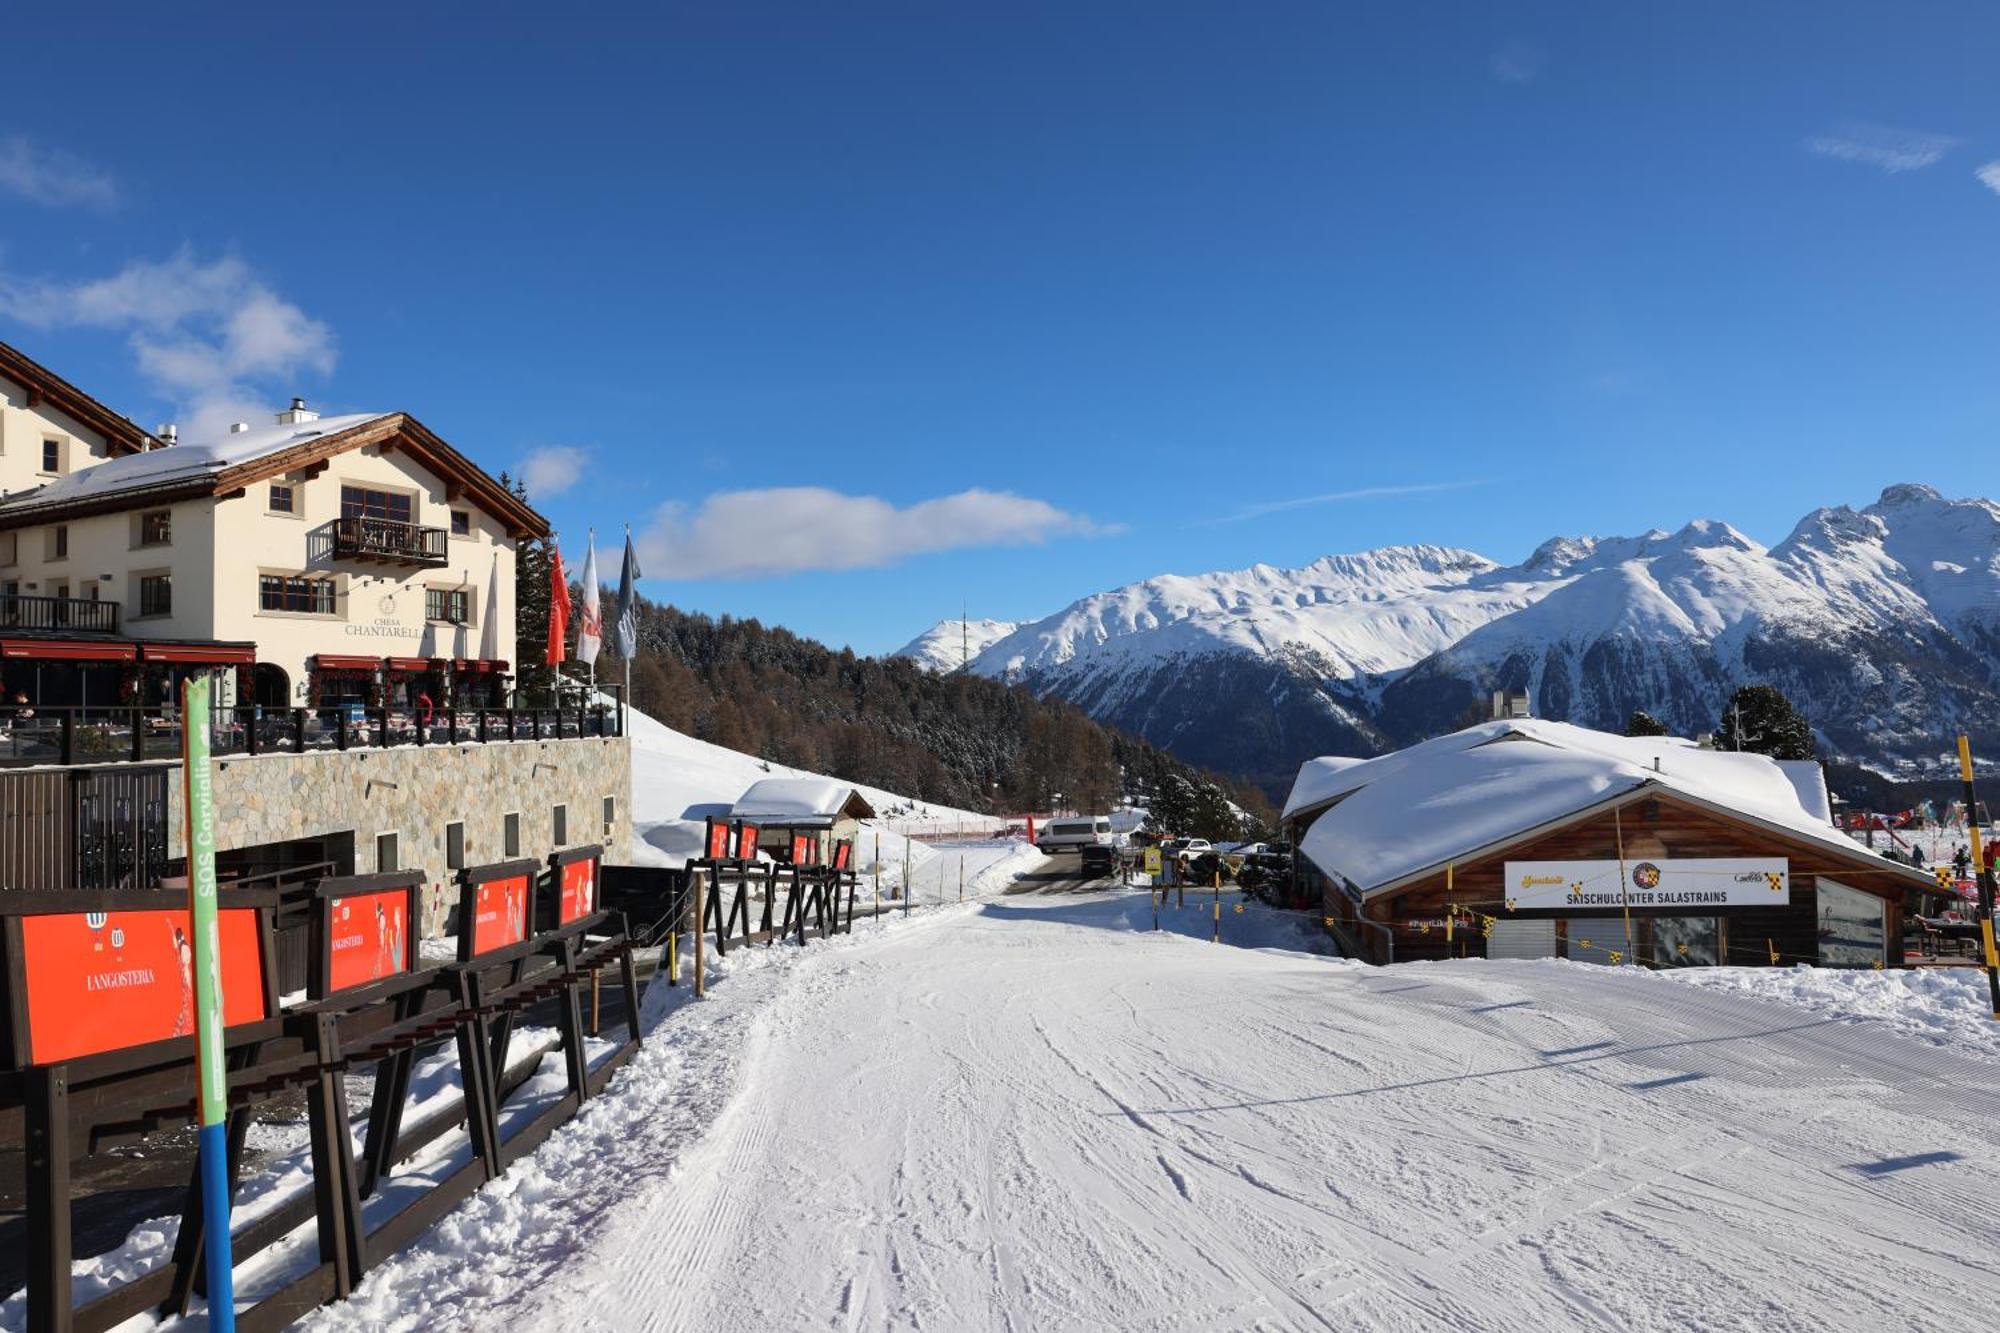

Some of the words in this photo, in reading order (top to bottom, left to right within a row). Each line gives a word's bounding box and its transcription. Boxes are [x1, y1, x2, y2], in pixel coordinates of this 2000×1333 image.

[345, 624, 428, 639] CHANTARELLA
[374, 618, 400, 626] CHESA
[195, 755, 213, 846] Corviglia
[198, 851, 214, 898] SOS
[1658, 891, 1728, 904] SALASTRAINS
[86, 968, 155, 992] LANGOSTERIA
